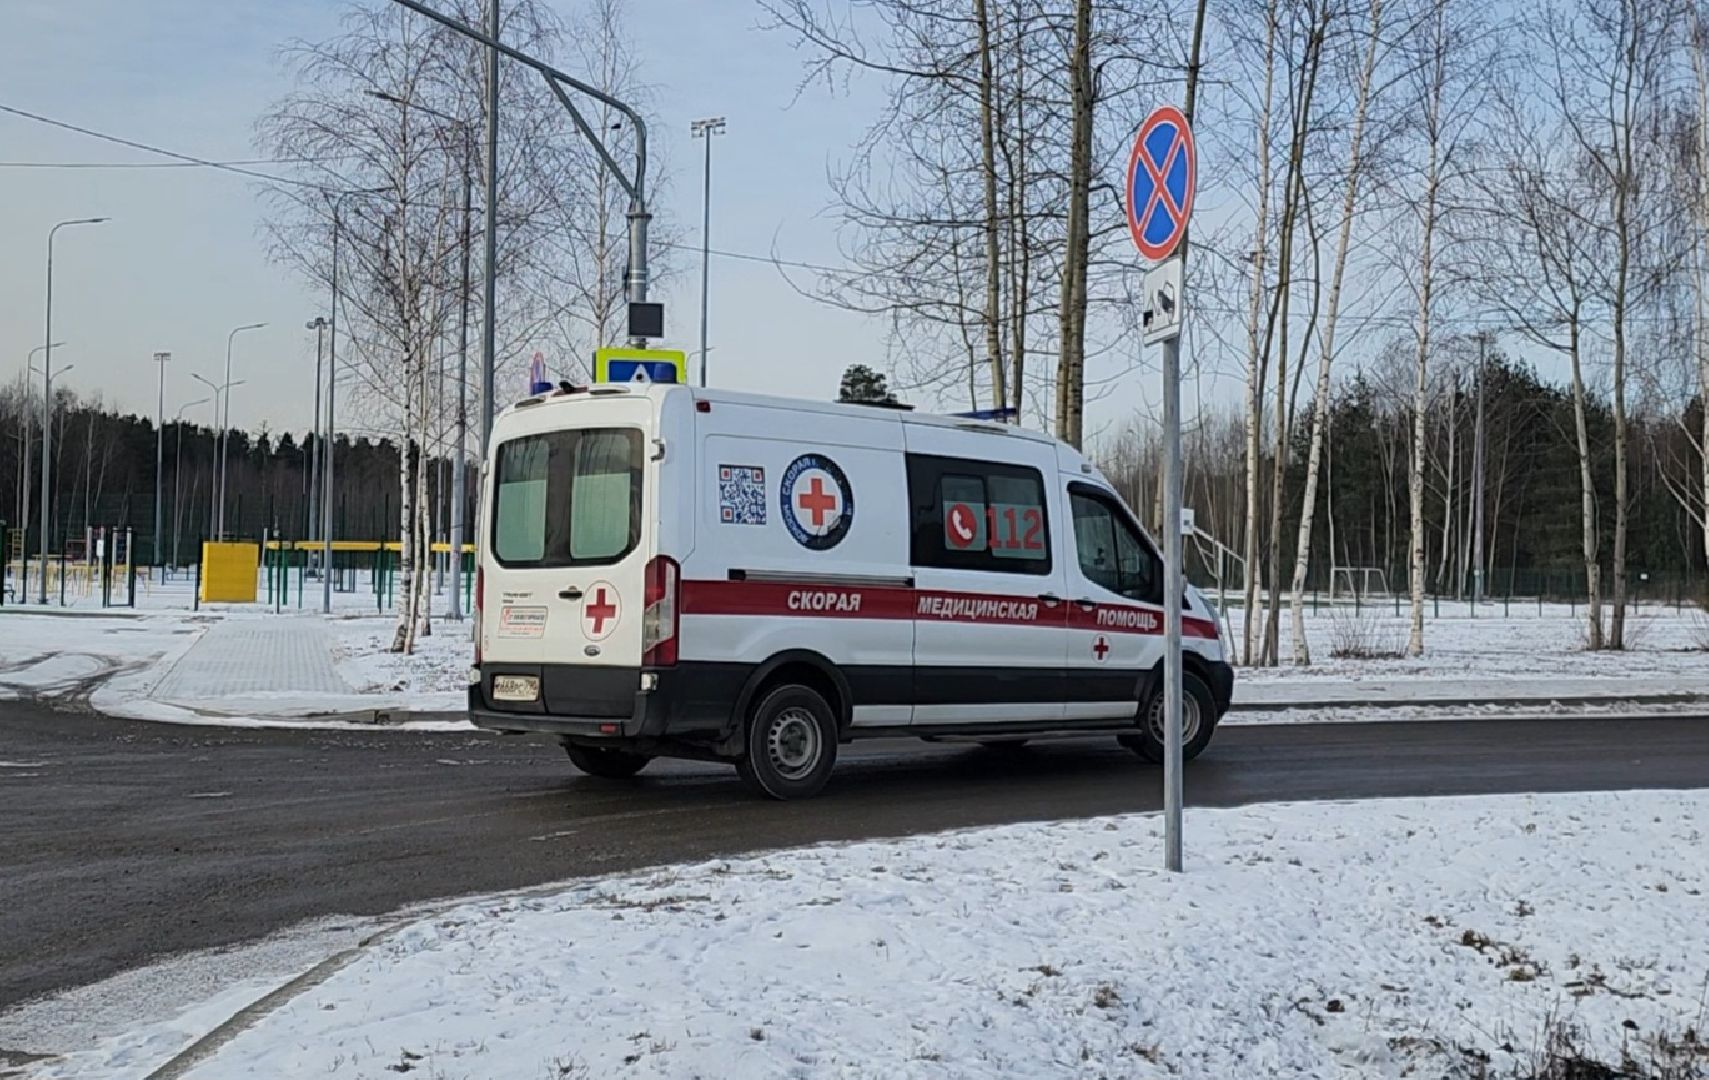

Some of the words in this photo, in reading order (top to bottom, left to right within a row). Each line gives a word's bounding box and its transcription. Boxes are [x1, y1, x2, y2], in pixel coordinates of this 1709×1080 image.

[985, 507, 1043, 549] 112
[787, 590, 862, 612] СКОРАЯ
[917, 596, 1038, 620] МЕДИЦИНСКАЯ
[1097, 608, 1158, 631] ПОМОЩЬ
